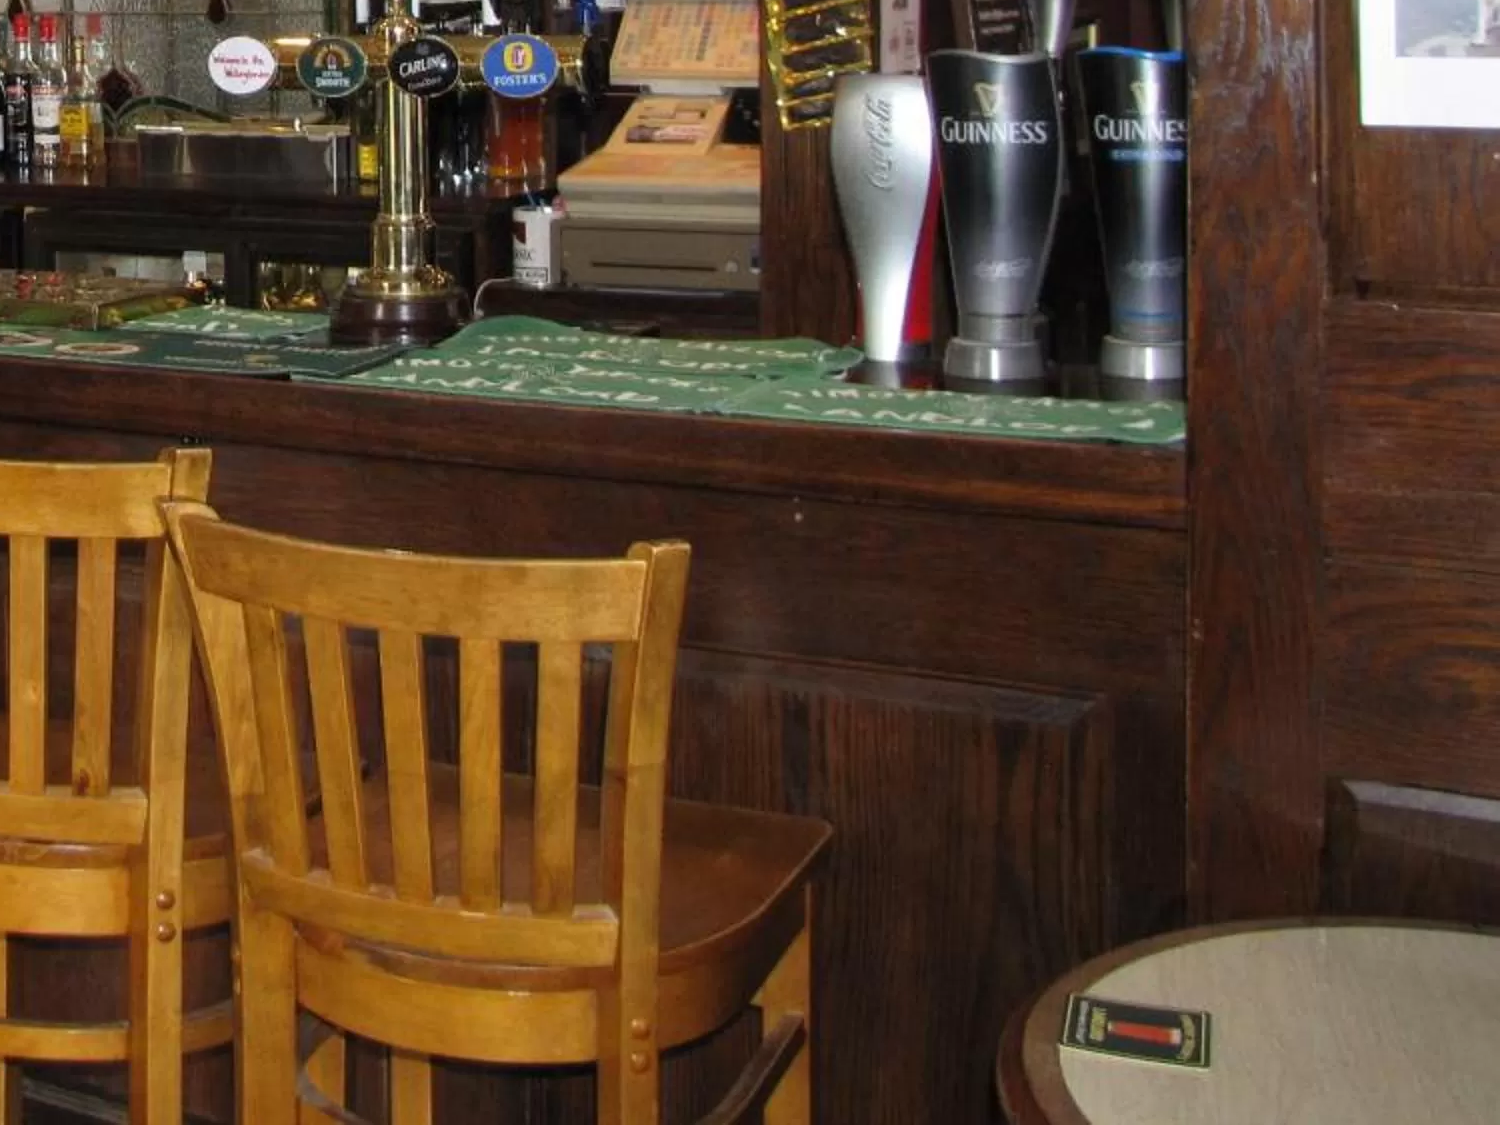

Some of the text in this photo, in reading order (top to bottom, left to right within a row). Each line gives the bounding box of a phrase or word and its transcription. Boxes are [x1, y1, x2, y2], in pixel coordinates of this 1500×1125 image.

[400, 53, 447, 77] CARLING
[493, 74, 547, 87] FOSTER'S
[941, 116, 1048, 143] GUINNESS
[1094, 114, 1187, 142] GUINNE
